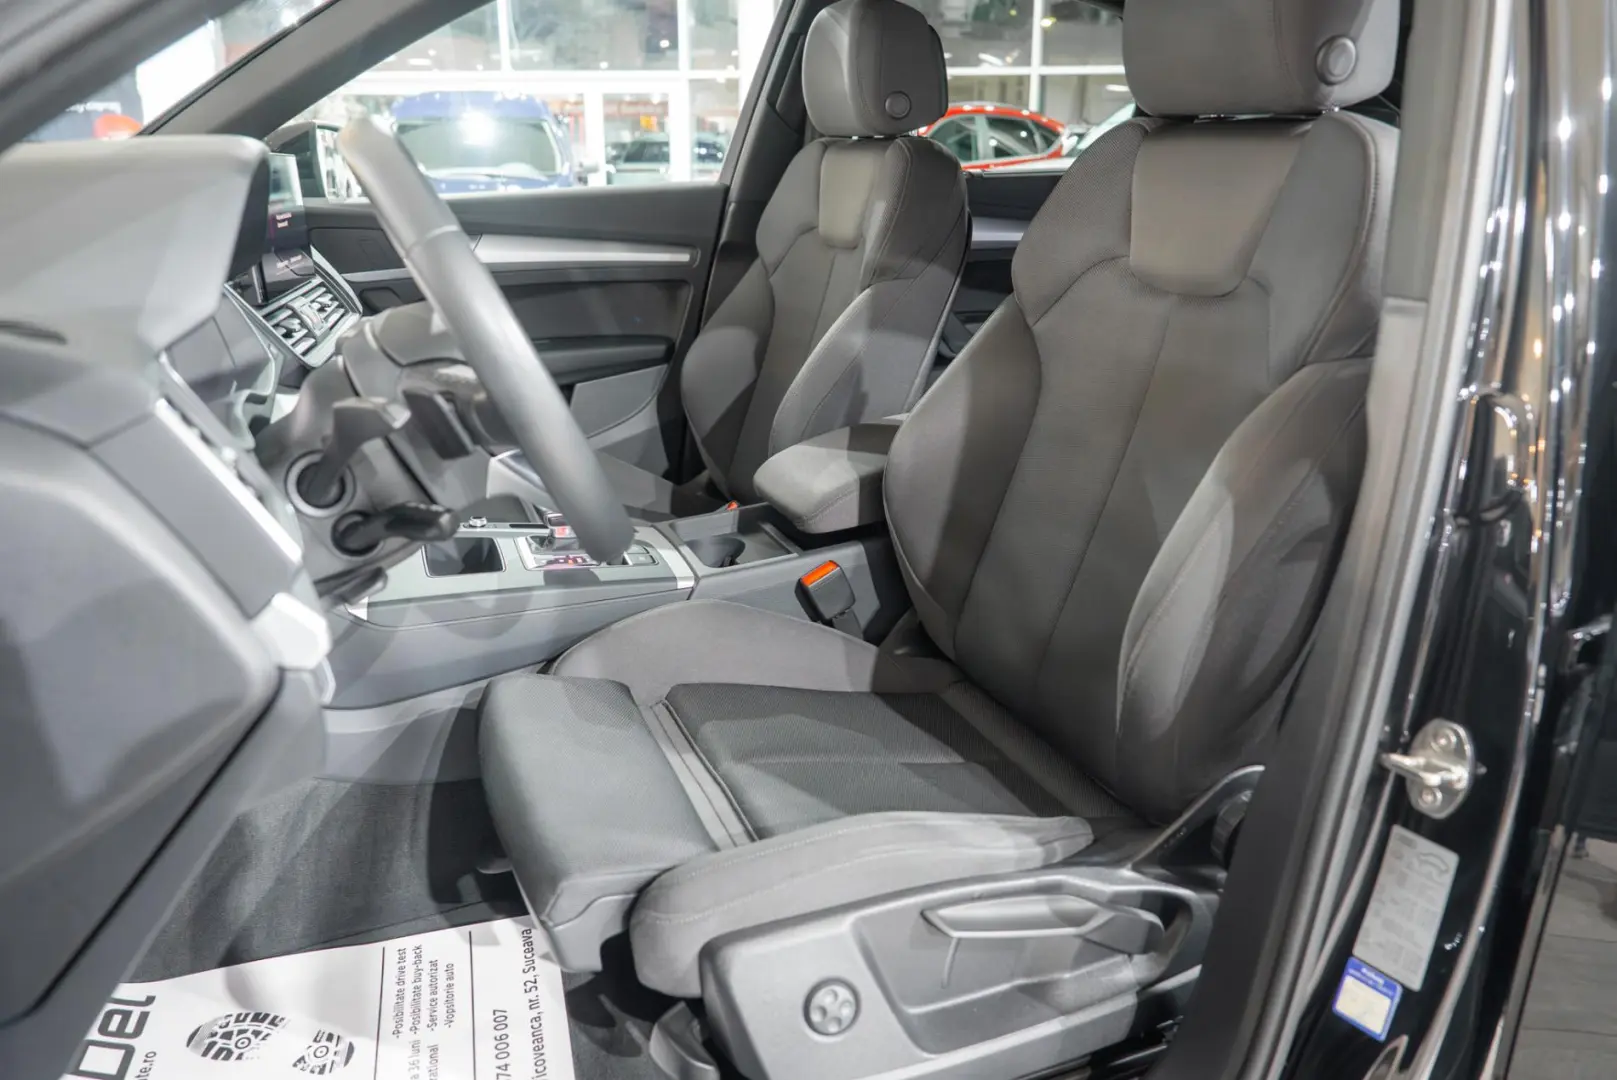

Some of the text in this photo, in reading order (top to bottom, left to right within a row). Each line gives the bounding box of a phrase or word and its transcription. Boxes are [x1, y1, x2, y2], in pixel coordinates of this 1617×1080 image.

[397, 947, 406, 965] test
[411, 944, 423, 984] buy-back
[395, 966, 406, 988] drive
[444, 963, 454, 982] auto
[427, 959, 438, 1032] -Service autorizat
[521, 928, 547, 1080] icoveanca, nr. 52, Suceava
[493, 1008, 508, 1031] 007
[408, 1040, 421, 1059] luni
[494, 1033, 510, 1060] 006
[134, 1051, 157, 1080] te.ro
